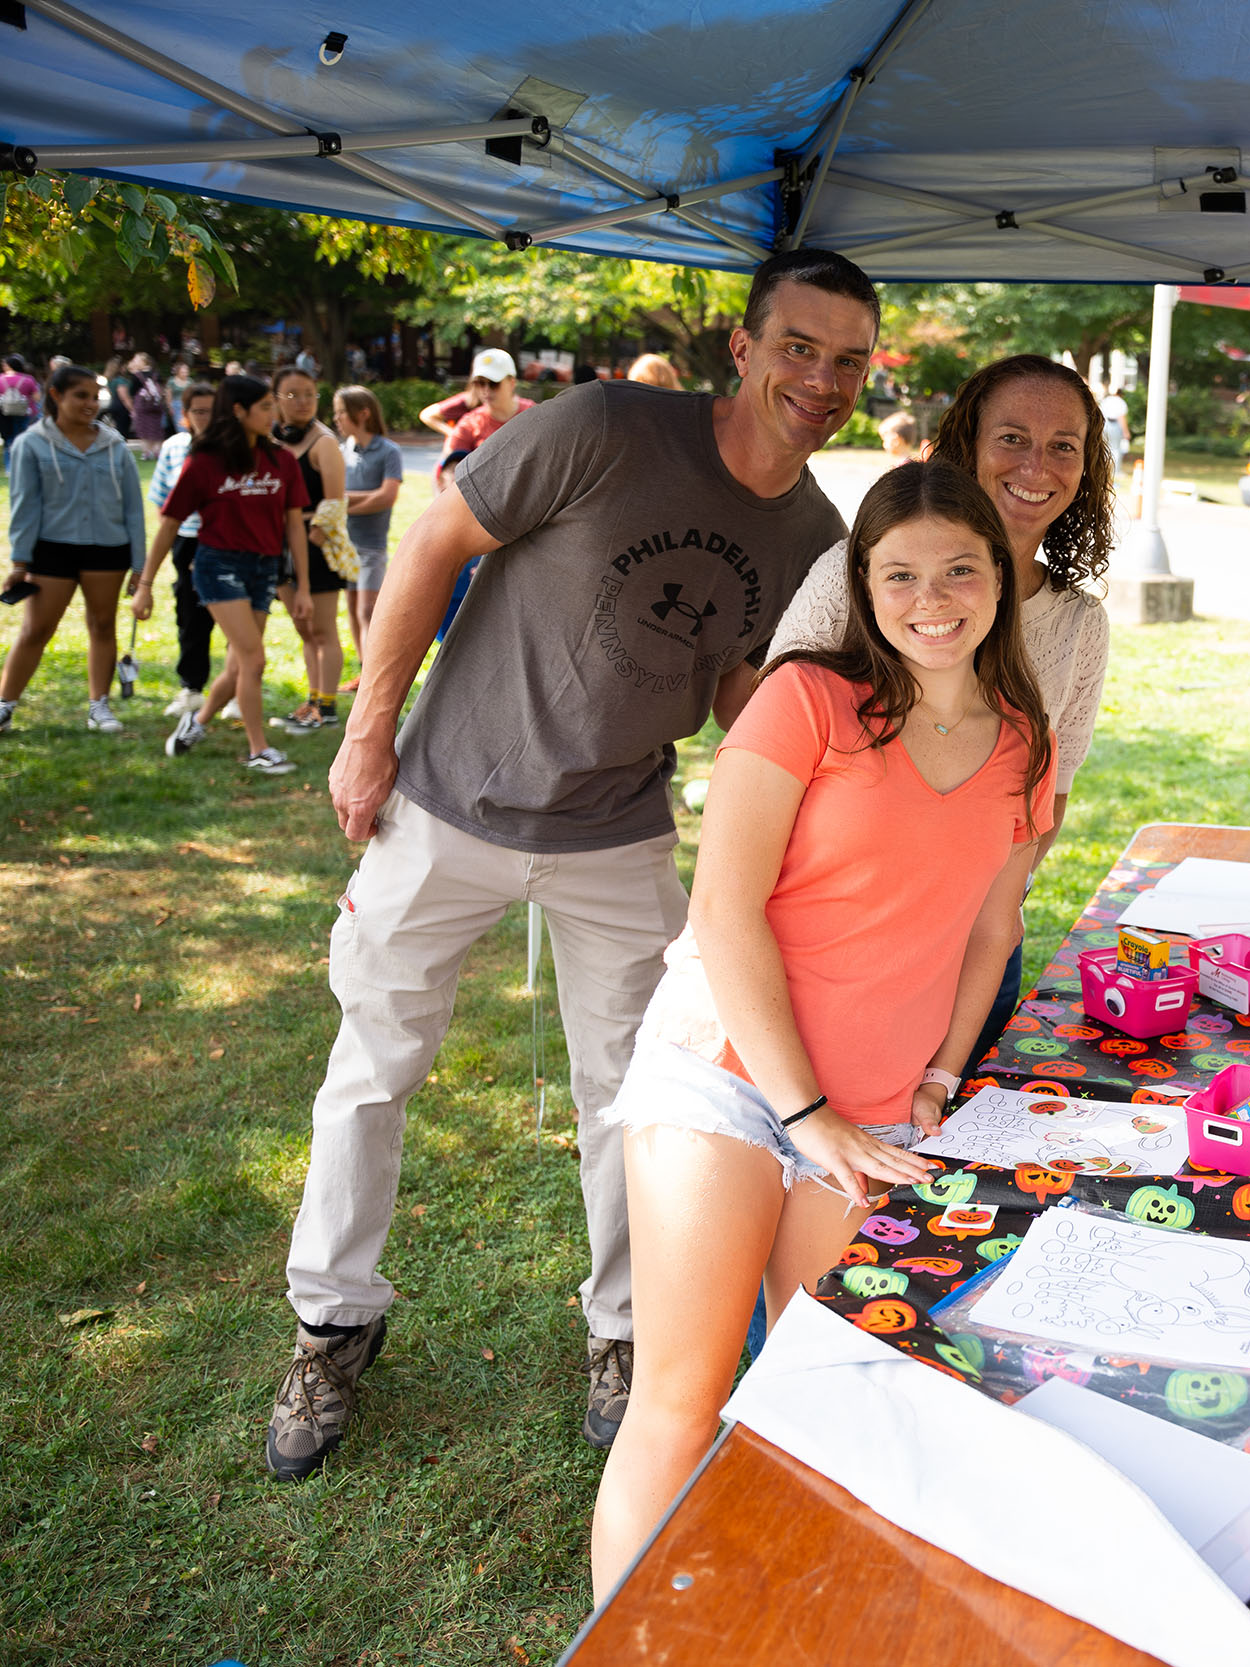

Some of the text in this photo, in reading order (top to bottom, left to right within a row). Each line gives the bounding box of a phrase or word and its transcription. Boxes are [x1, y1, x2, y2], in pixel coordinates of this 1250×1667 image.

[611, 529, 761, 638] PHILADELPHIA
[637, 617, 668, 636] UNDER
[1123, 937, 1149, 954] Crayola
